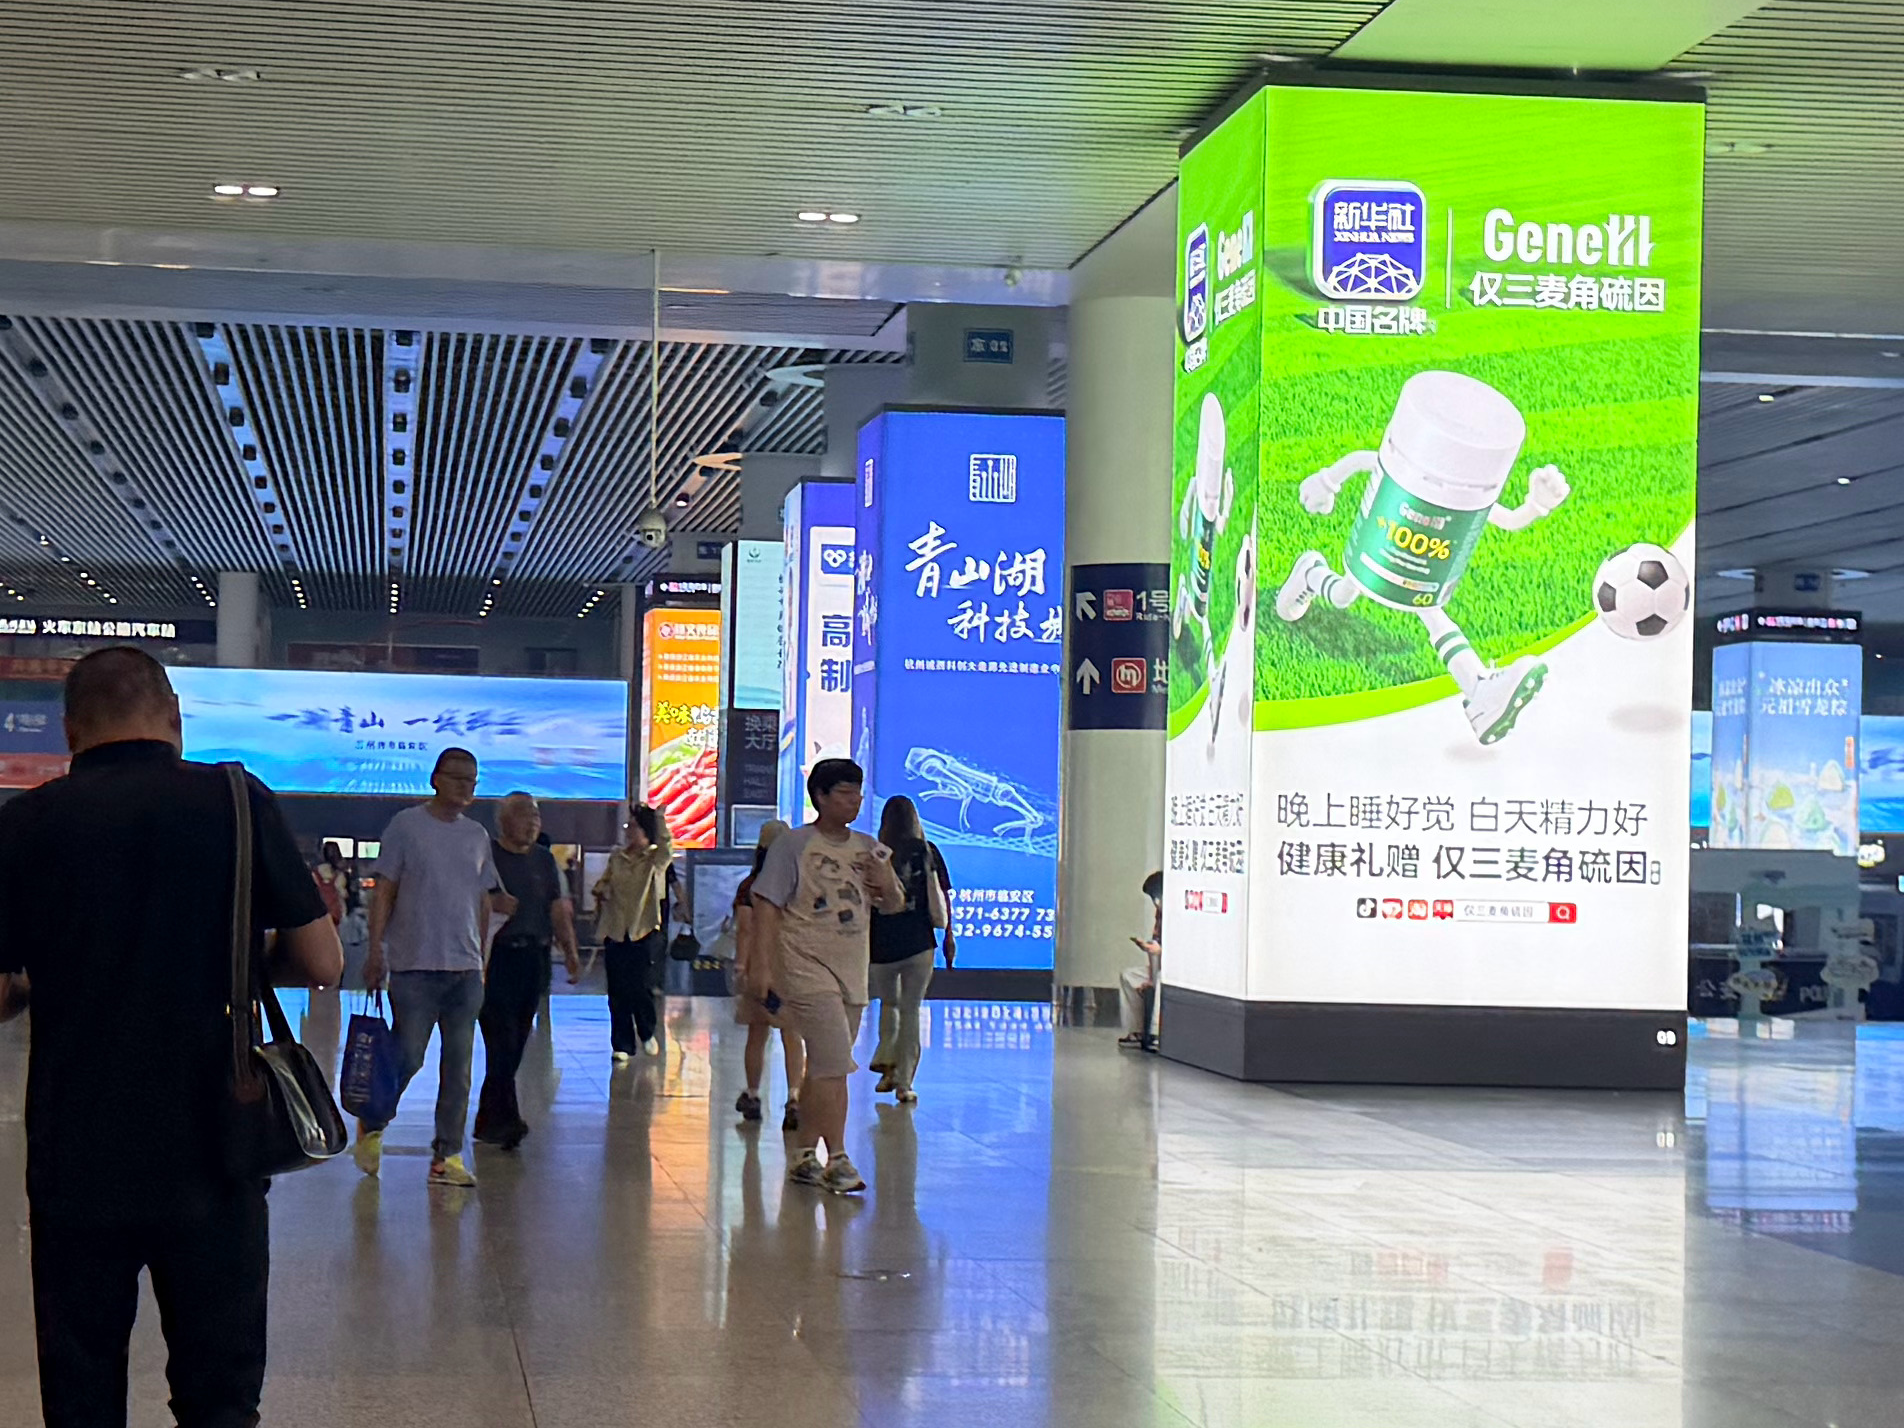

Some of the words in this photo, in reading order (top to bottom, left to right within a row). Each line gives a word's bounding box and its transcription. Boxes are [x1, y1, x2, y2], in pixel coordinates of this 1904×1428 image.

[1333, 201, 1416, 232] 新华社
[1470, 273, 1665, 312] 仅三麦角硫因
[1318, 306, 1430, 335] 中国名牌
[905, 521, 1047, 598] 青山湖
[1277, 793, 1455, 832] 晚上睡好觉
[1470, 797, 1648, 836] 白天精力好
[1277, 841, 1420, 879] 健康礼赠
[1432, 845, 1648, 884] 仅三麦角硫因
[951, 906, 1030, 921] 571-6377
